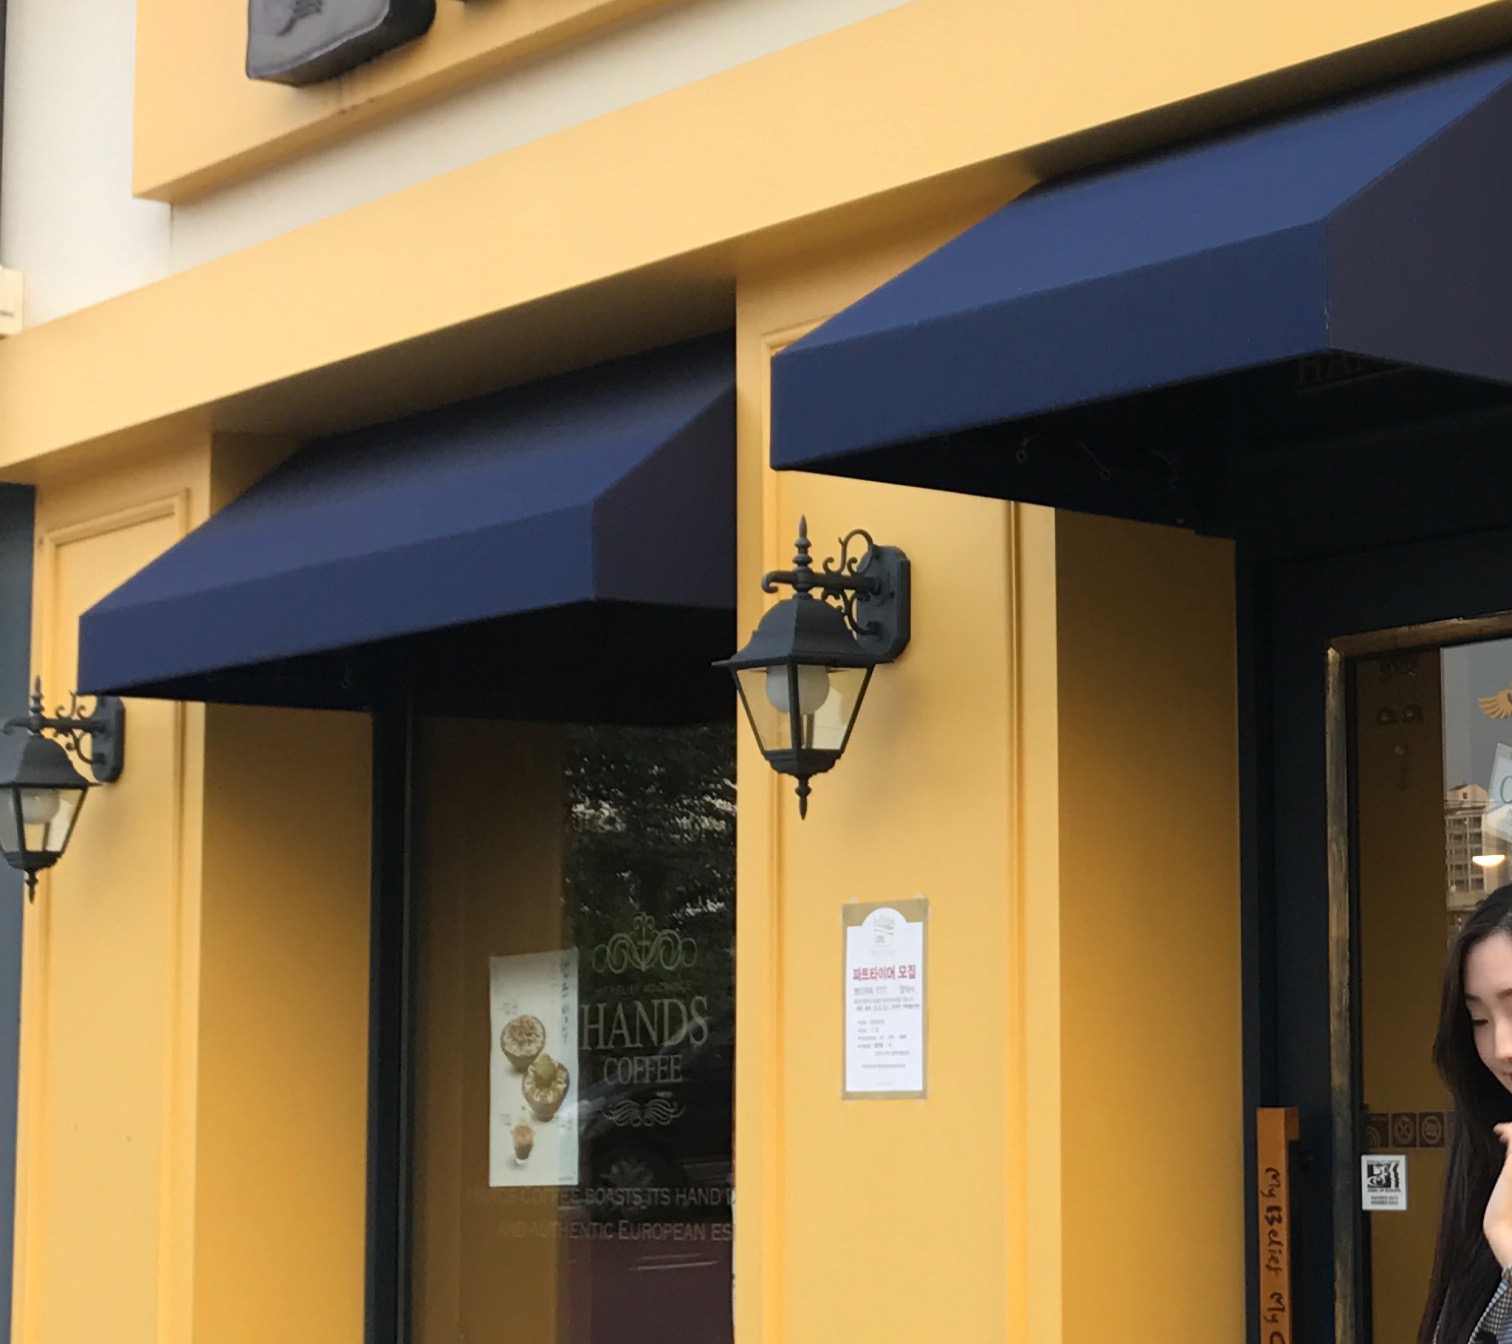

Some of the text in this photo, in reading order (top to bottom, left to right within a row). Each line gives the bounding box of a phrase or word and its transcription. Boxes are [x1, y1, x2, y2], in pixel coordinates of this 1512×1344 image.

[580, 995, 710, 1050] HANDS
[603, 1054, 684, 1086] COFFEE
[675, 1187, 721, 1205] HAND
[618, 1219, 706, 1241] EUROPEAN
